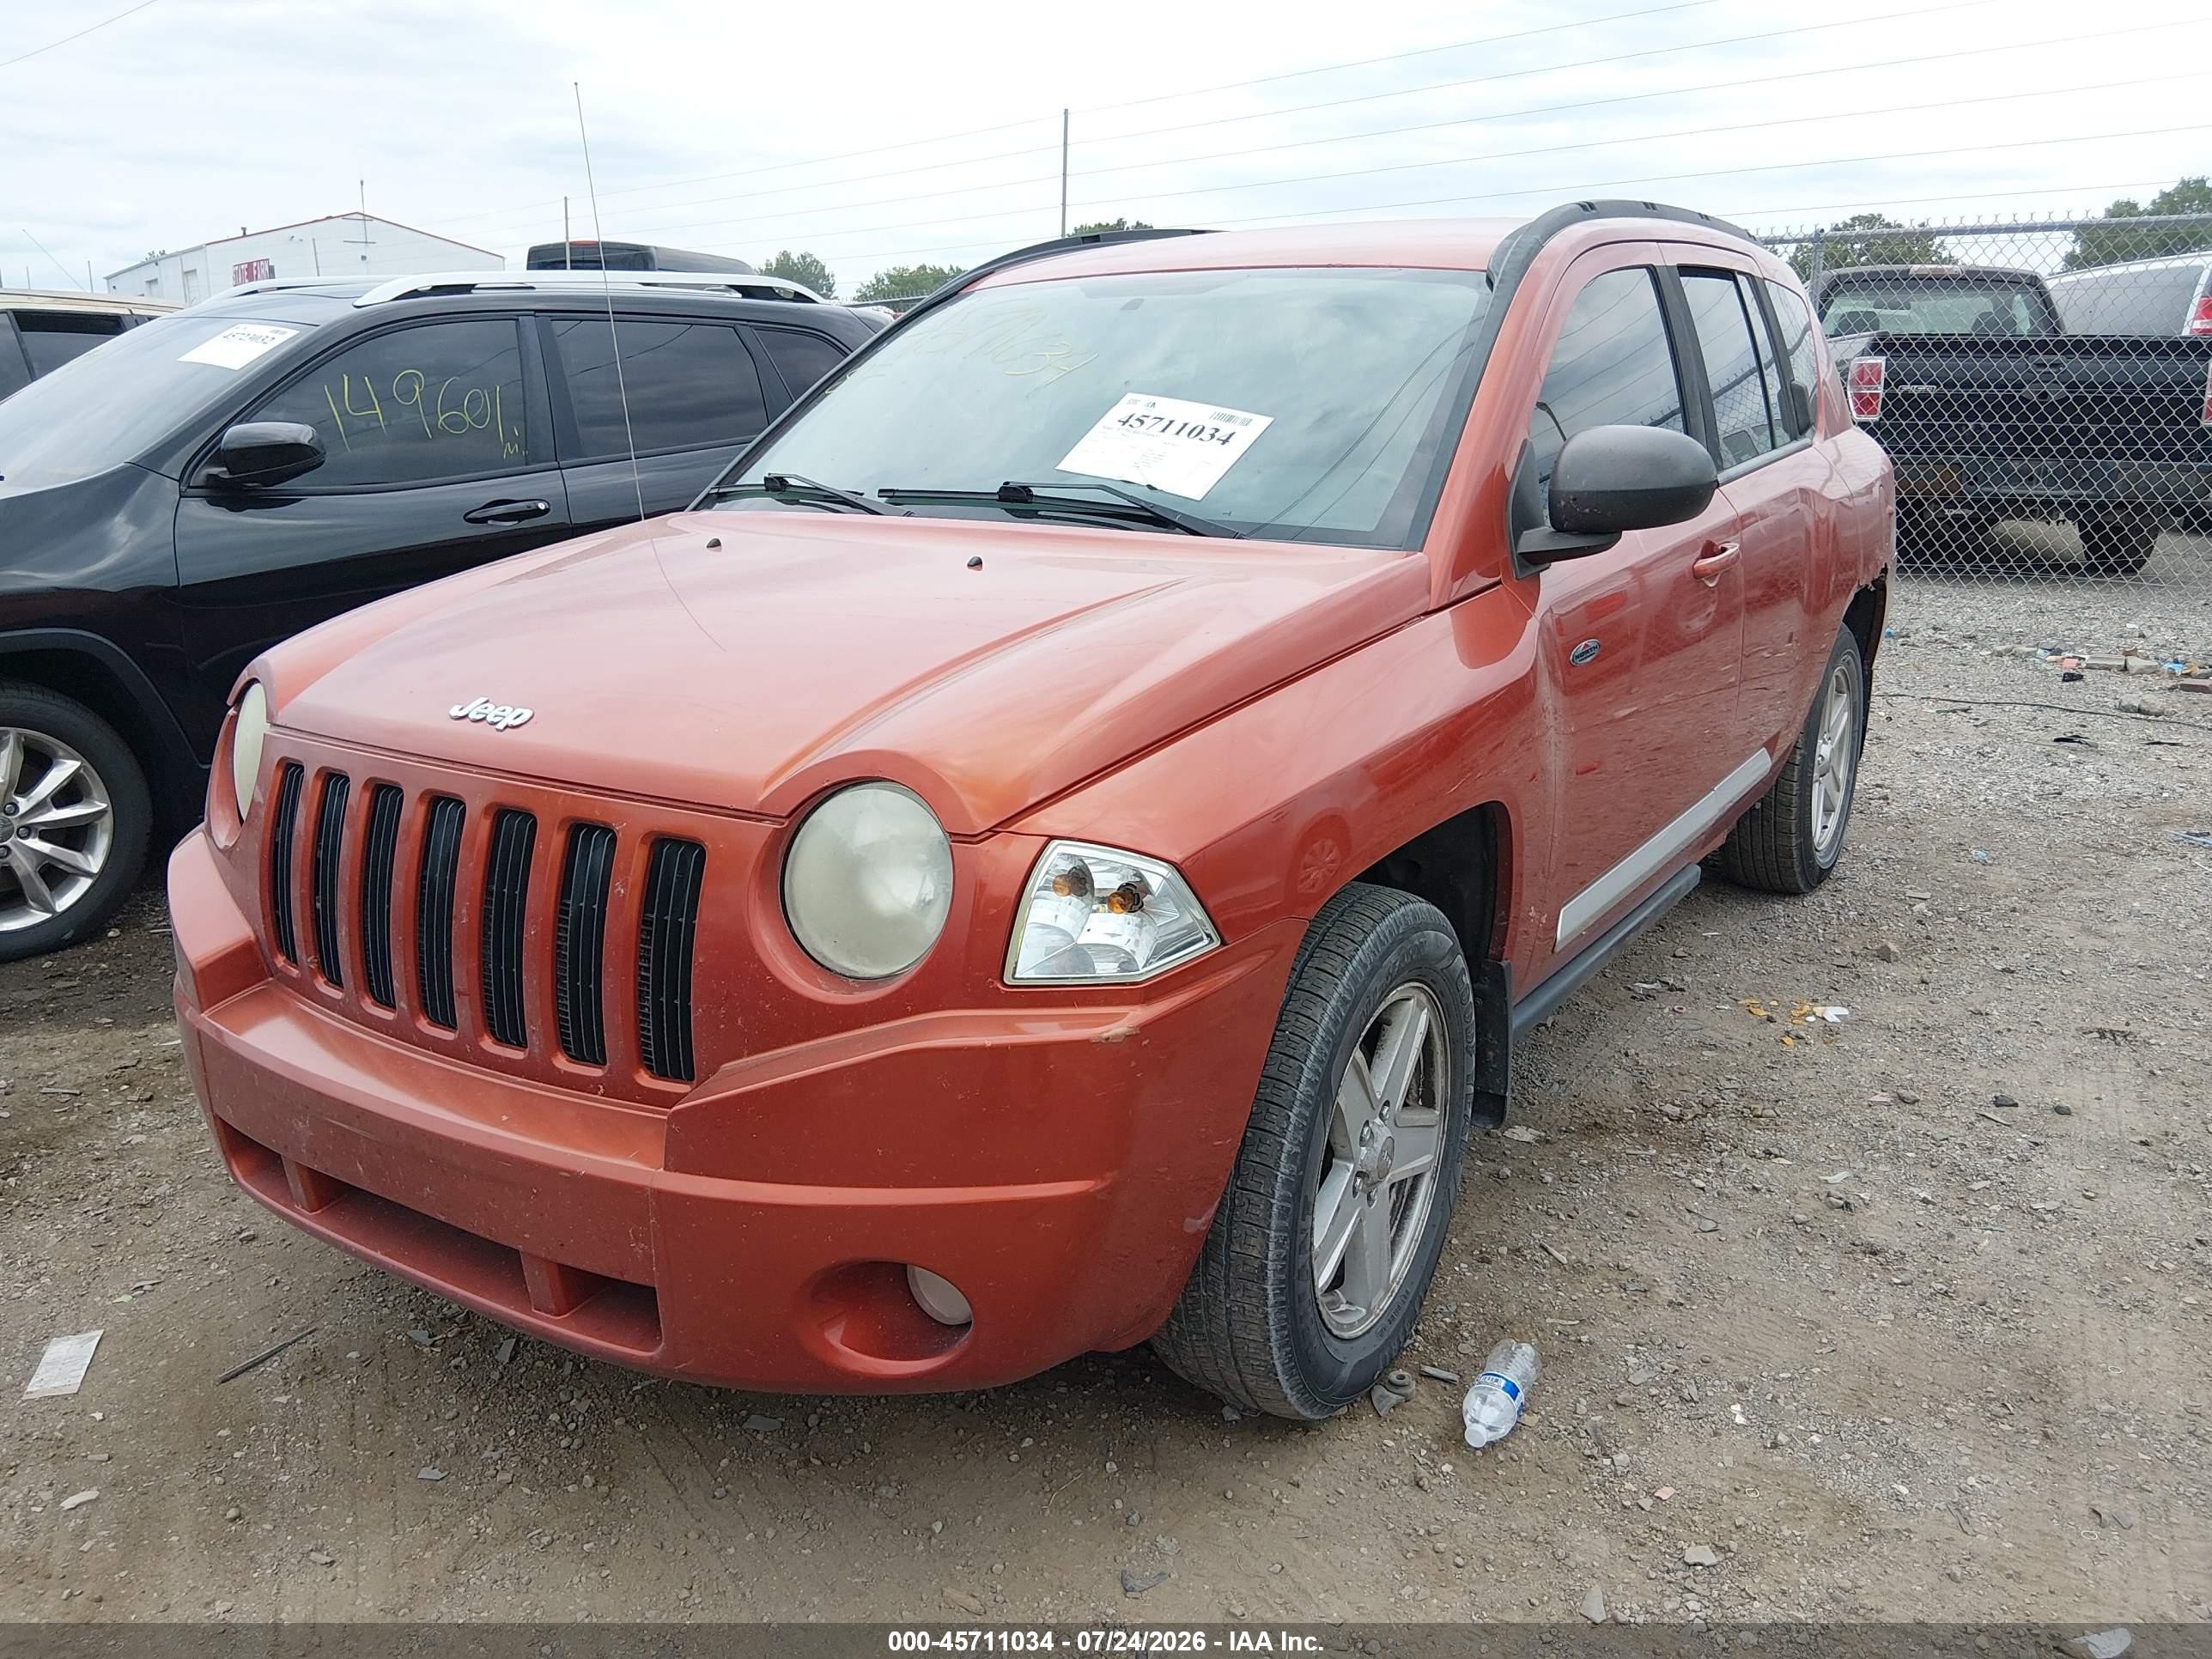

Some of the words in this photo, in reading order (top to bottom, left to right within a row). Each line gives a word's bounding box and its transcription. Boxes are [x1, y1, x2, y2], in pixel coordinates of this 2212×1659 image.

[325, 369, 503, 453] 149601
[1117, 412, 1237, 446] 45711034
[1574, 645, 1598, 660] NORTH
[449, 696, 534, 732] Jeep
